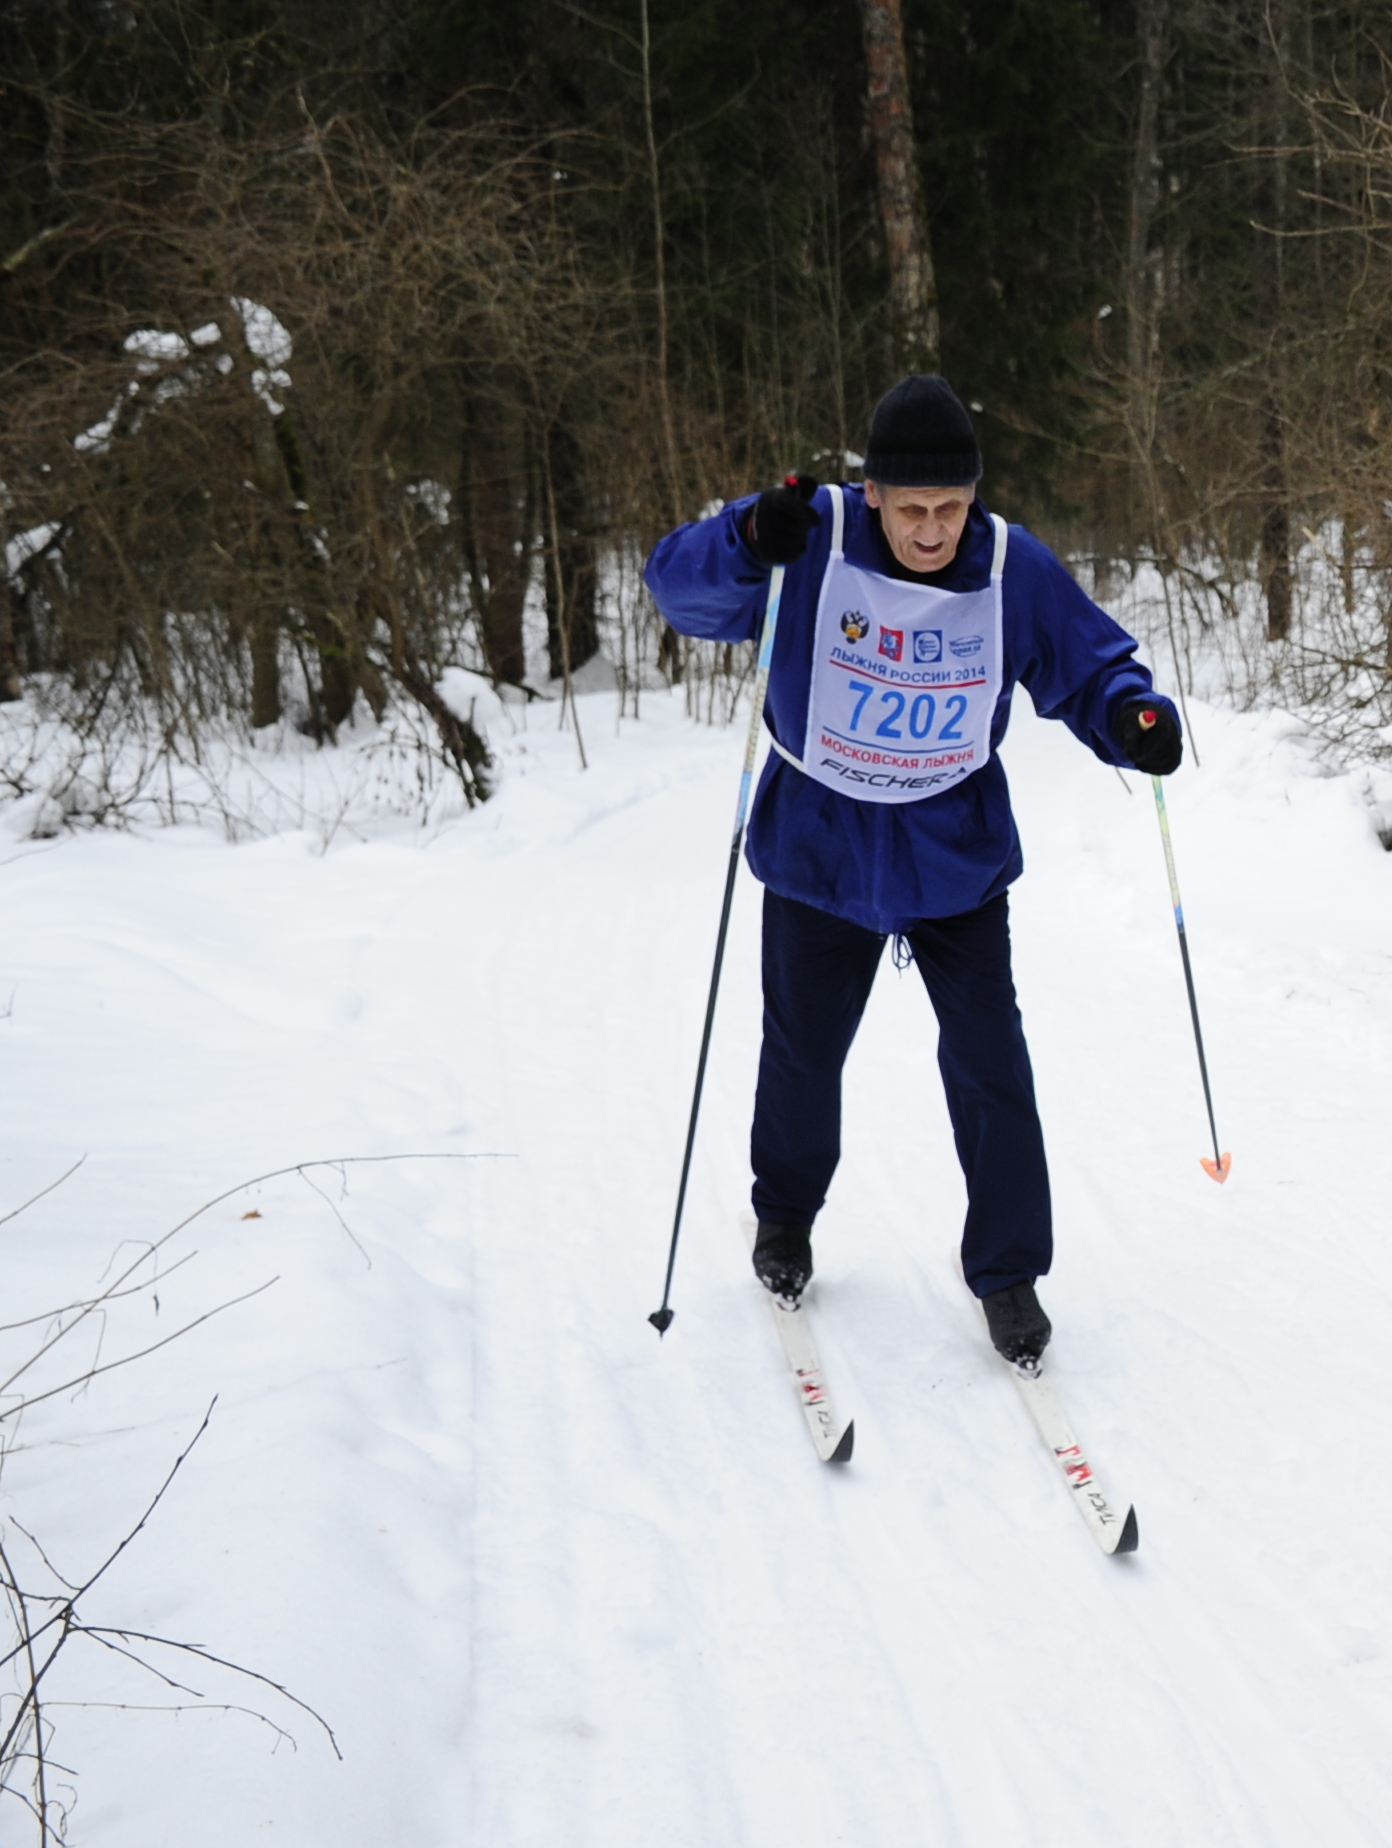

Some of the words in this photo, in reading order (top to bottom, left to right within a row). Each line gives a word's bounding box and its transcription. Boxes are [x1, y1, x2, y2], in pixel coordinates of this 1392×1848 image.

[830, 646, 887, 677] ЛЫЖНЯ
[890, 669, 951, 683] РОССИИ
[954, 665, 986, 681] 2014
[848, 680, 968, 741] 7202
[820, 734, 919, 769] МОСКОВСКАЯ
[923, 749, 974, 769] ЛЫЖНЯ
[819, 758, 949, 789] FISCHER
